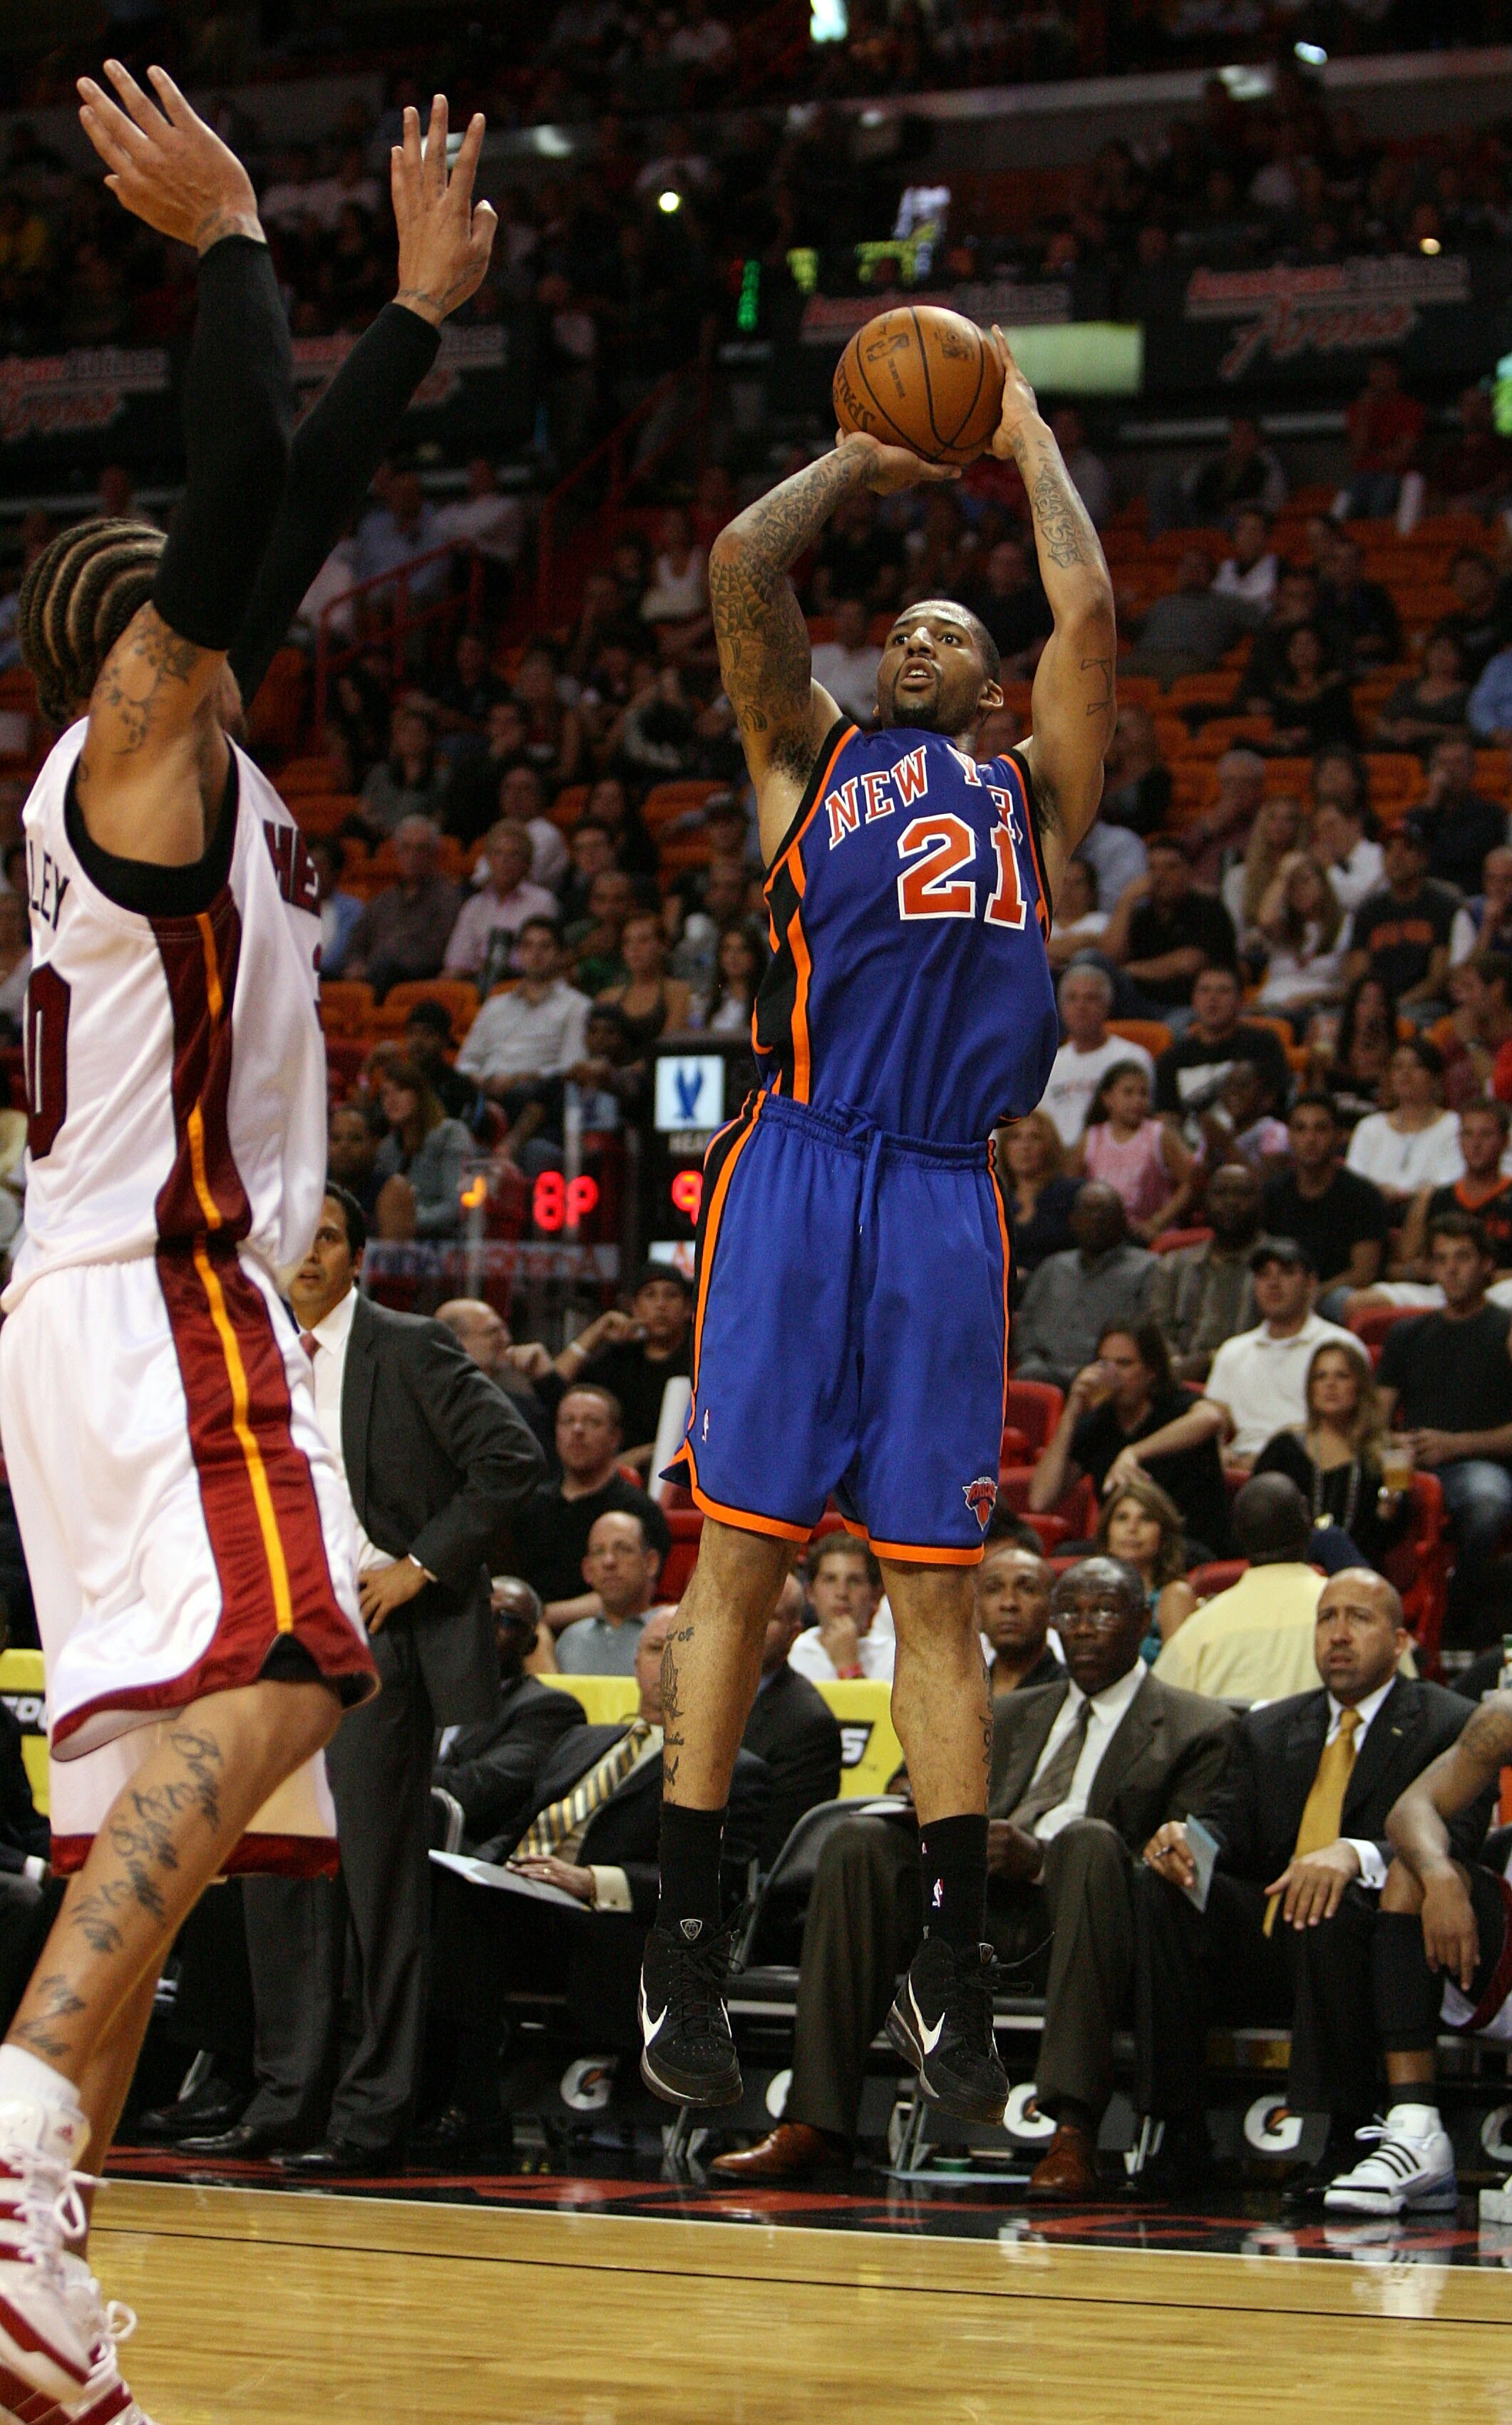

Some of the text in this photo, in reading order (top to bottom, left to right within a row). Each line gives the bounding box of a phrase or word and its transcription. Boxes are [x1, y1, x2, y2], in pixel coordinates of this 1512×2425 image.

[825, 743, 1024, 850] NEW YR
[897, 813, 1027, 931] 21
[1243, 2093, 1305, 2153] G
